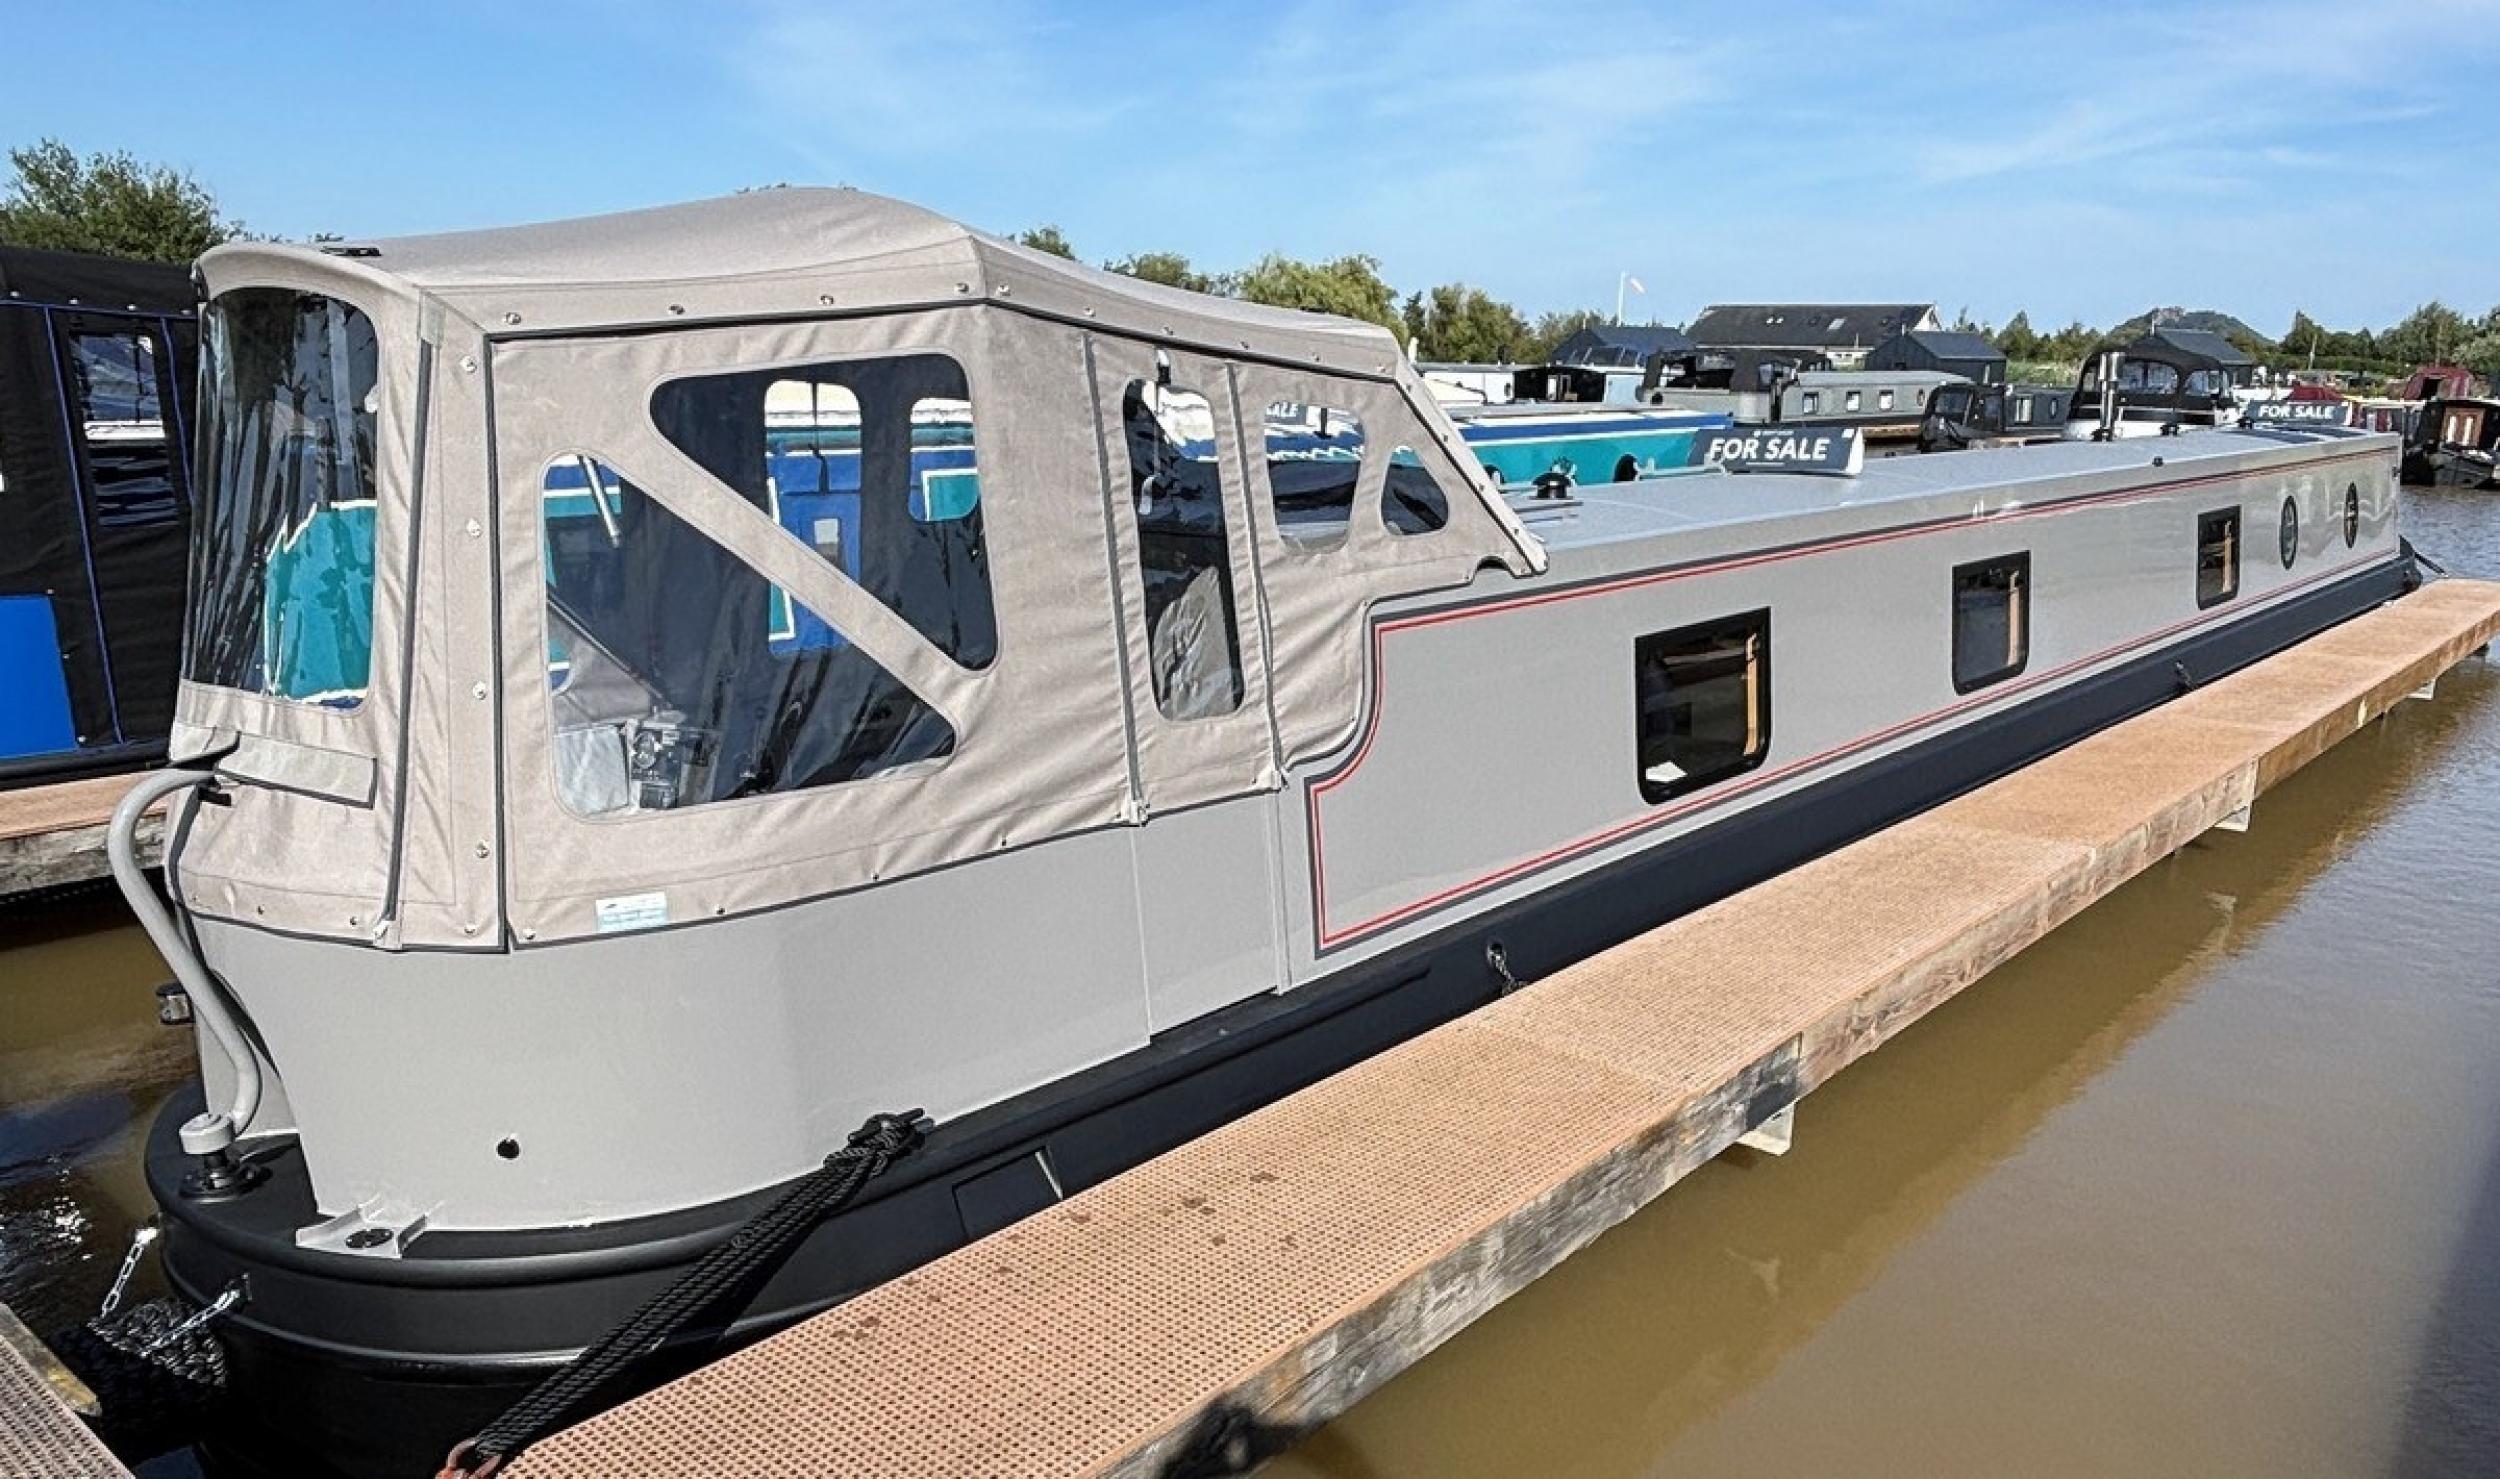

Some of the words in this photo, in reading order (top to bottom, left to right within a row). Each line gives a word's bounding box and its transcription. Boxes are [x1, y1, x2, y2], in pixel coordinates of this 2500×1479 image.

[2258, 405, 2291, 418] FOR
[2295, 405, 2335, 420] SALE
[1708, 437, 1759, 460] FOR
[1763, 437, 1831, 461] SALE
